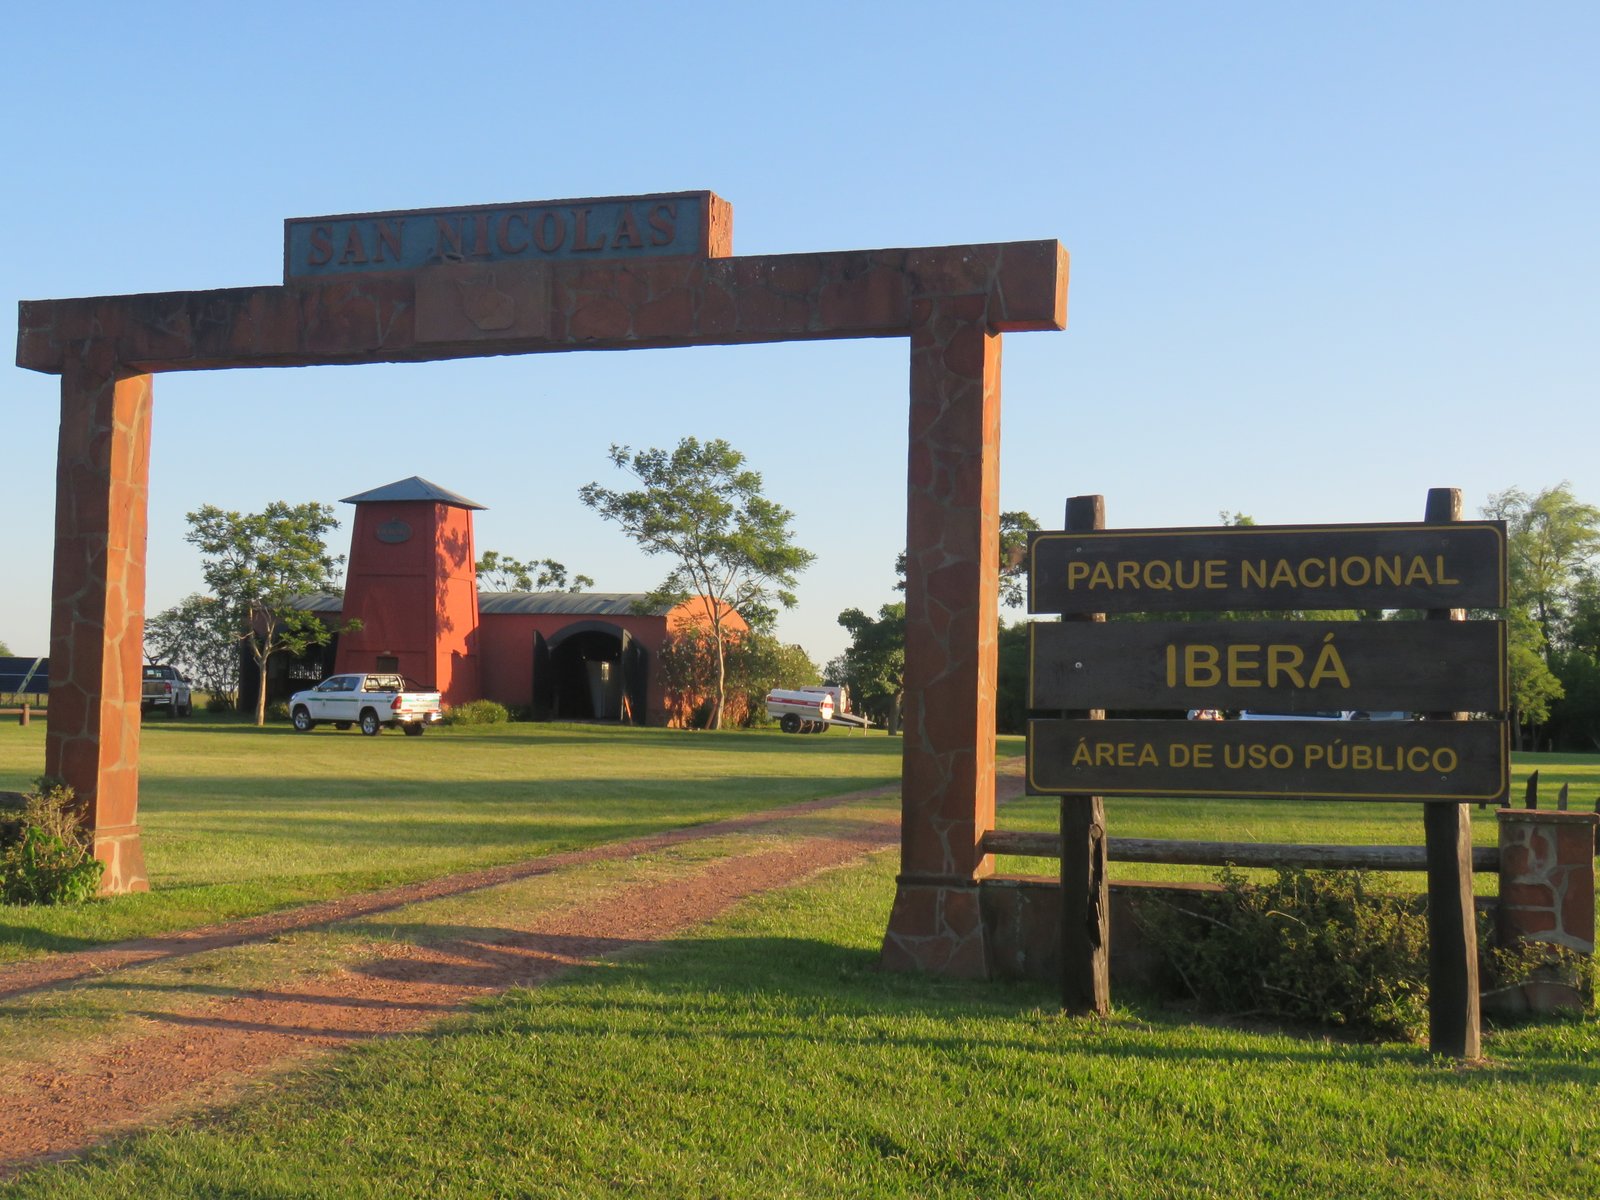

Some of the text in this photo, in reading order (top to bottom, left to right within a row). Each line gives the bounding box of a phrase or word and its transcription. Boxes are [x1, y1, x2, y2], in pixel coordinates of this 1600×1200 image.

[308, 203, 677, 266] SAN NICOLAS
[1067, 555, 1459, 591] PARQUE NACIONAL
[1166, 632, 1351, 689] IBERÁ
[1071, 737, 1458, 773] ÁREA DE USO PÚBLICO
